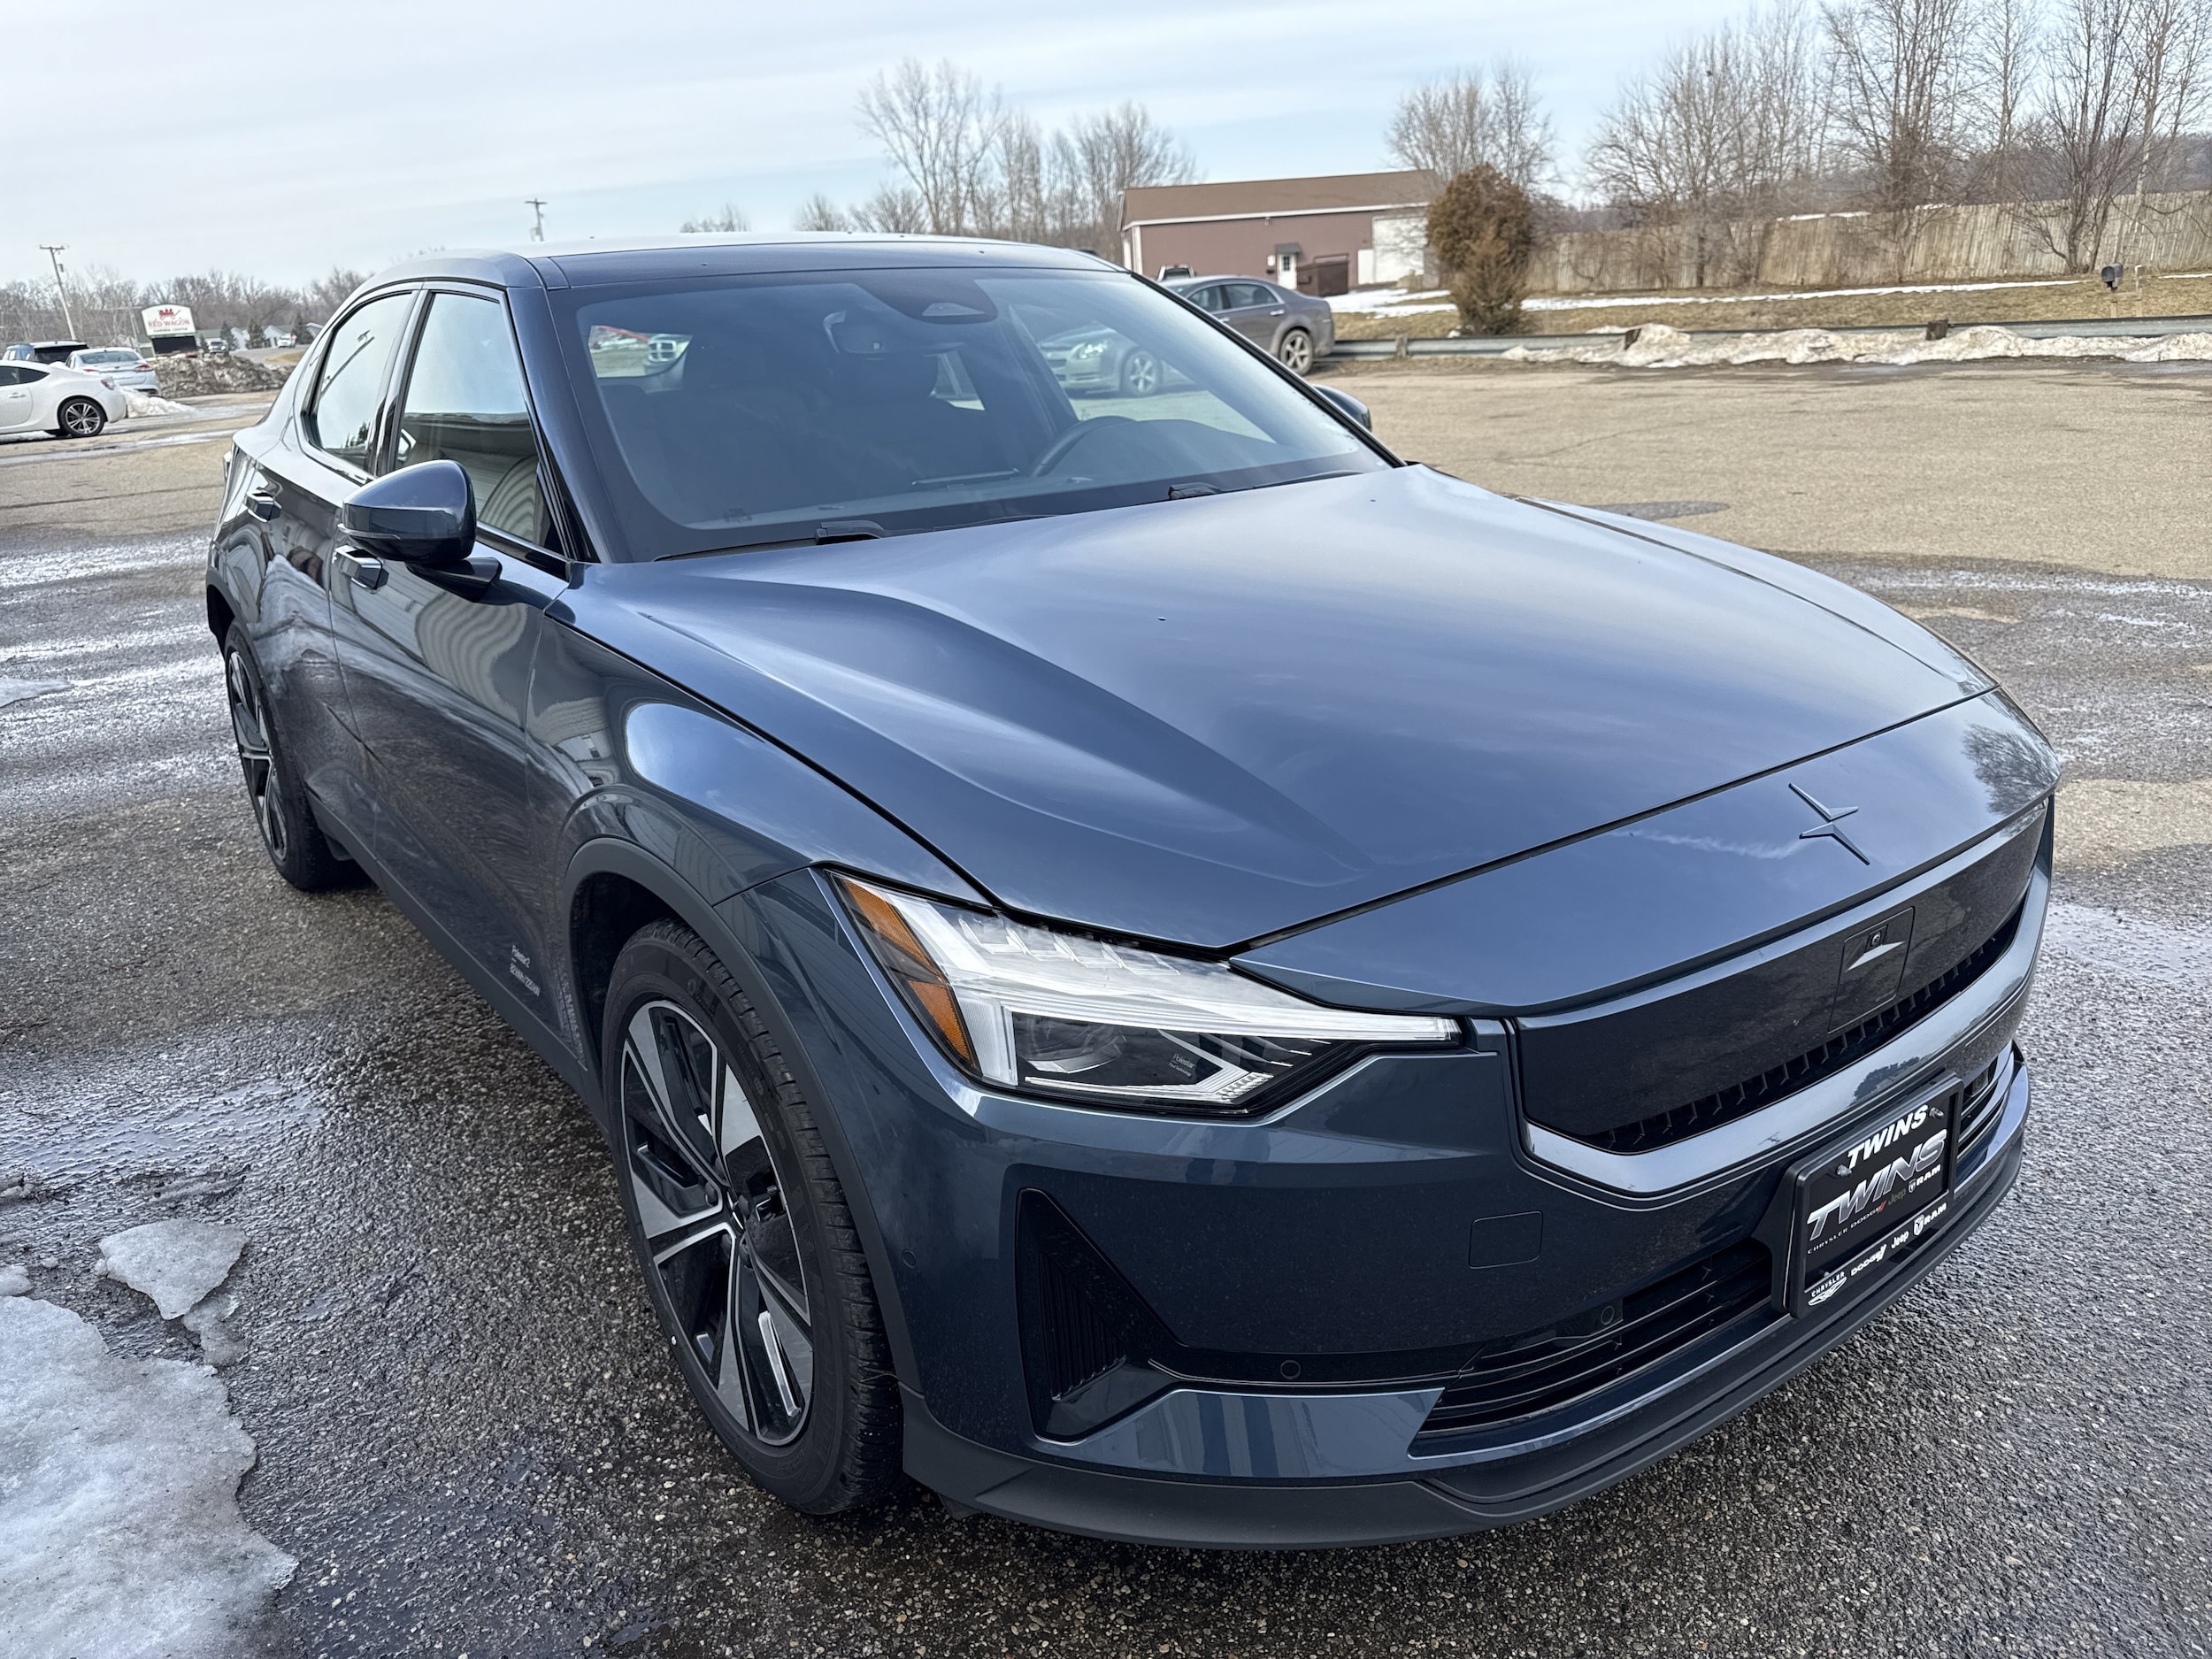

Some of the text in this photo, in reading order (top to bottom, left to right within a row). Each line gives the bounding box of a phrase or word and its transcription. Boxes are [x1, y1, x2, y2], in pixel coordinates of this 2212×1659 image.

[1172, 1053, 1194, 1069] Polestar
[1847, 1105, 1928, 1170] TWINS
[1807, 1129, 1947, 1240] TWINS
[1808, 1227, 1848, 1255] CHRYSLER
[1888, 1188, 1907, 1205] Jeep
[1916, 1164, 1941, 1187] RAM
[1811, 1202, 1947, 1298] CHRYSLER DODGE Jeep RAM
